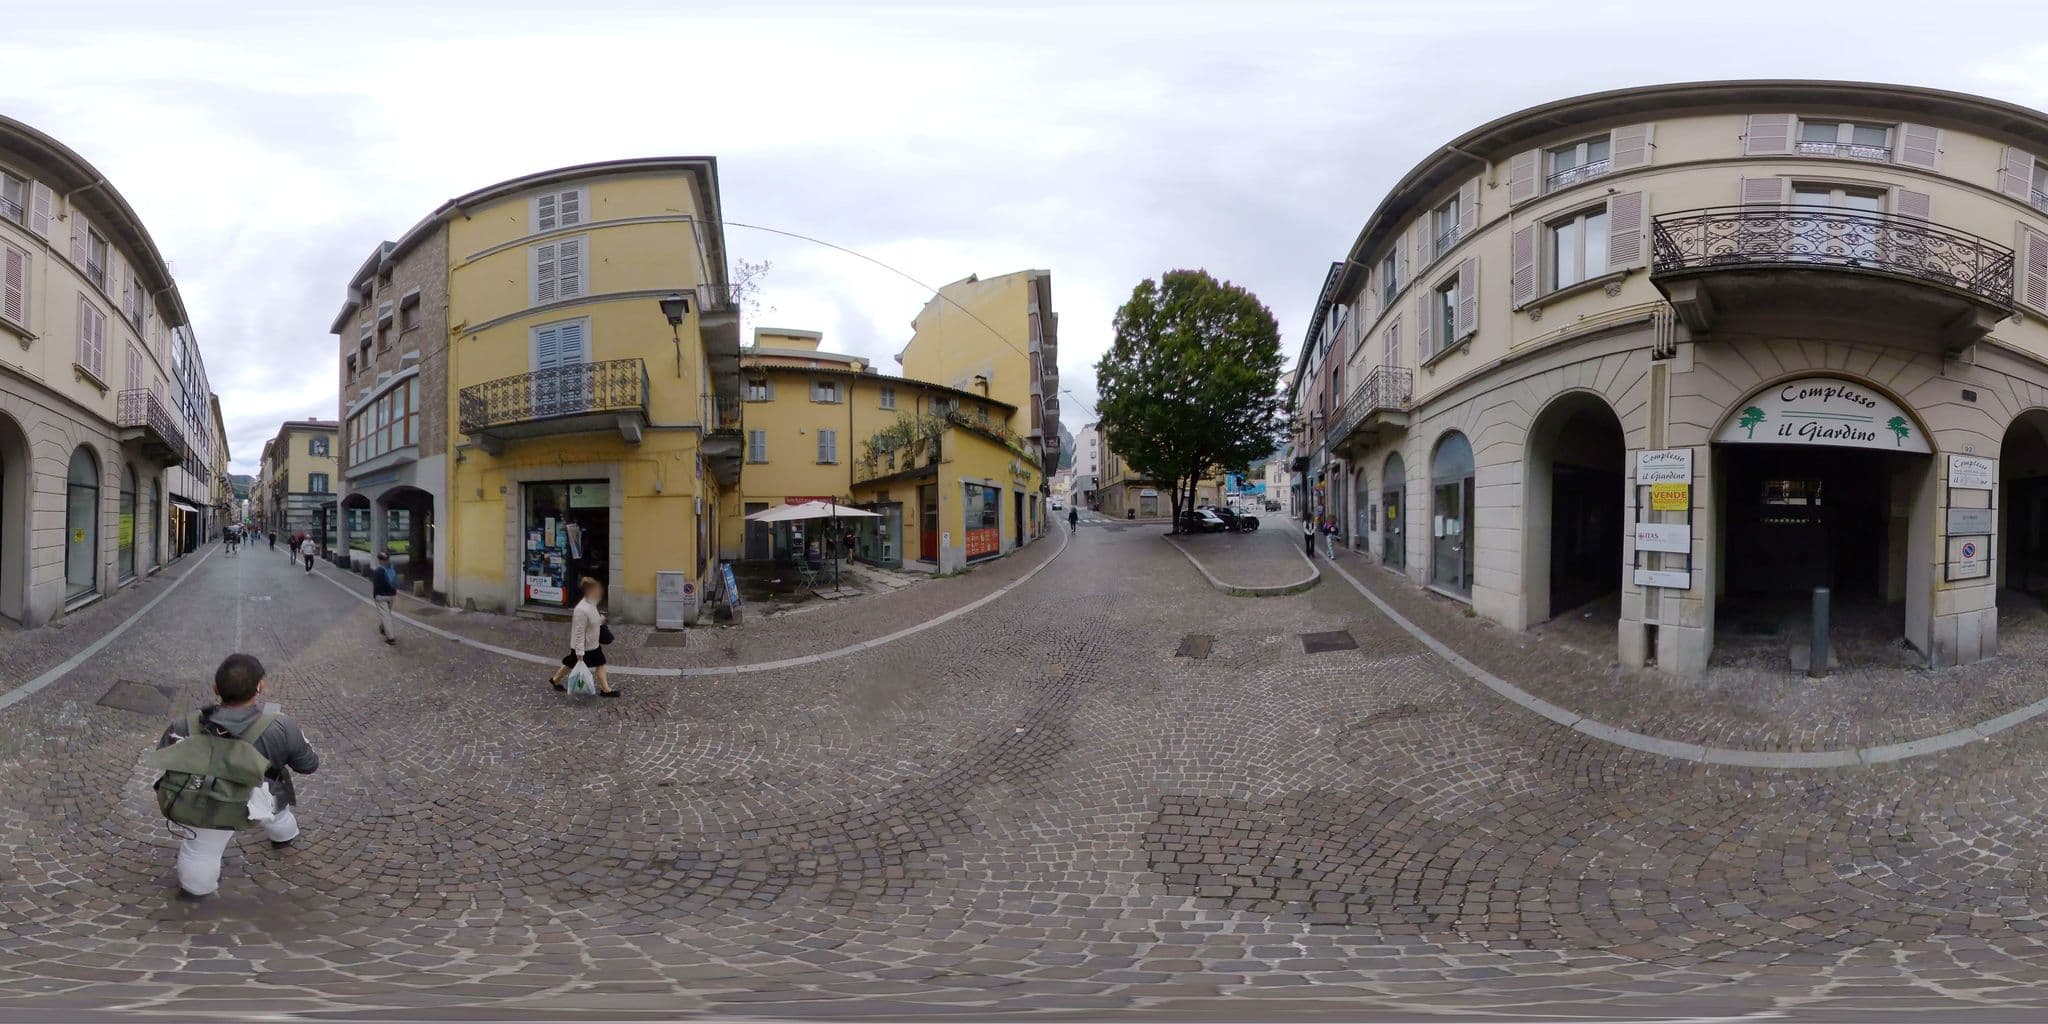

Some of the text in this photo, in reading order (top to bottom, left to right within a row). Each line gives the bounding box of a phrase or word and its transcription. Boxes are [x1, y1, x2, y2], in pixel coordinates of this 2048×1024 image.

[1781, 385, 1876, 409] Complesso
[1778, 422, 1876, 441] il Giardino
[1642, 451, 1685, 463] Complesso
[1953, 459, 1988, 471] Complesso
[1642, 471, 1685, 481] il Giardino
